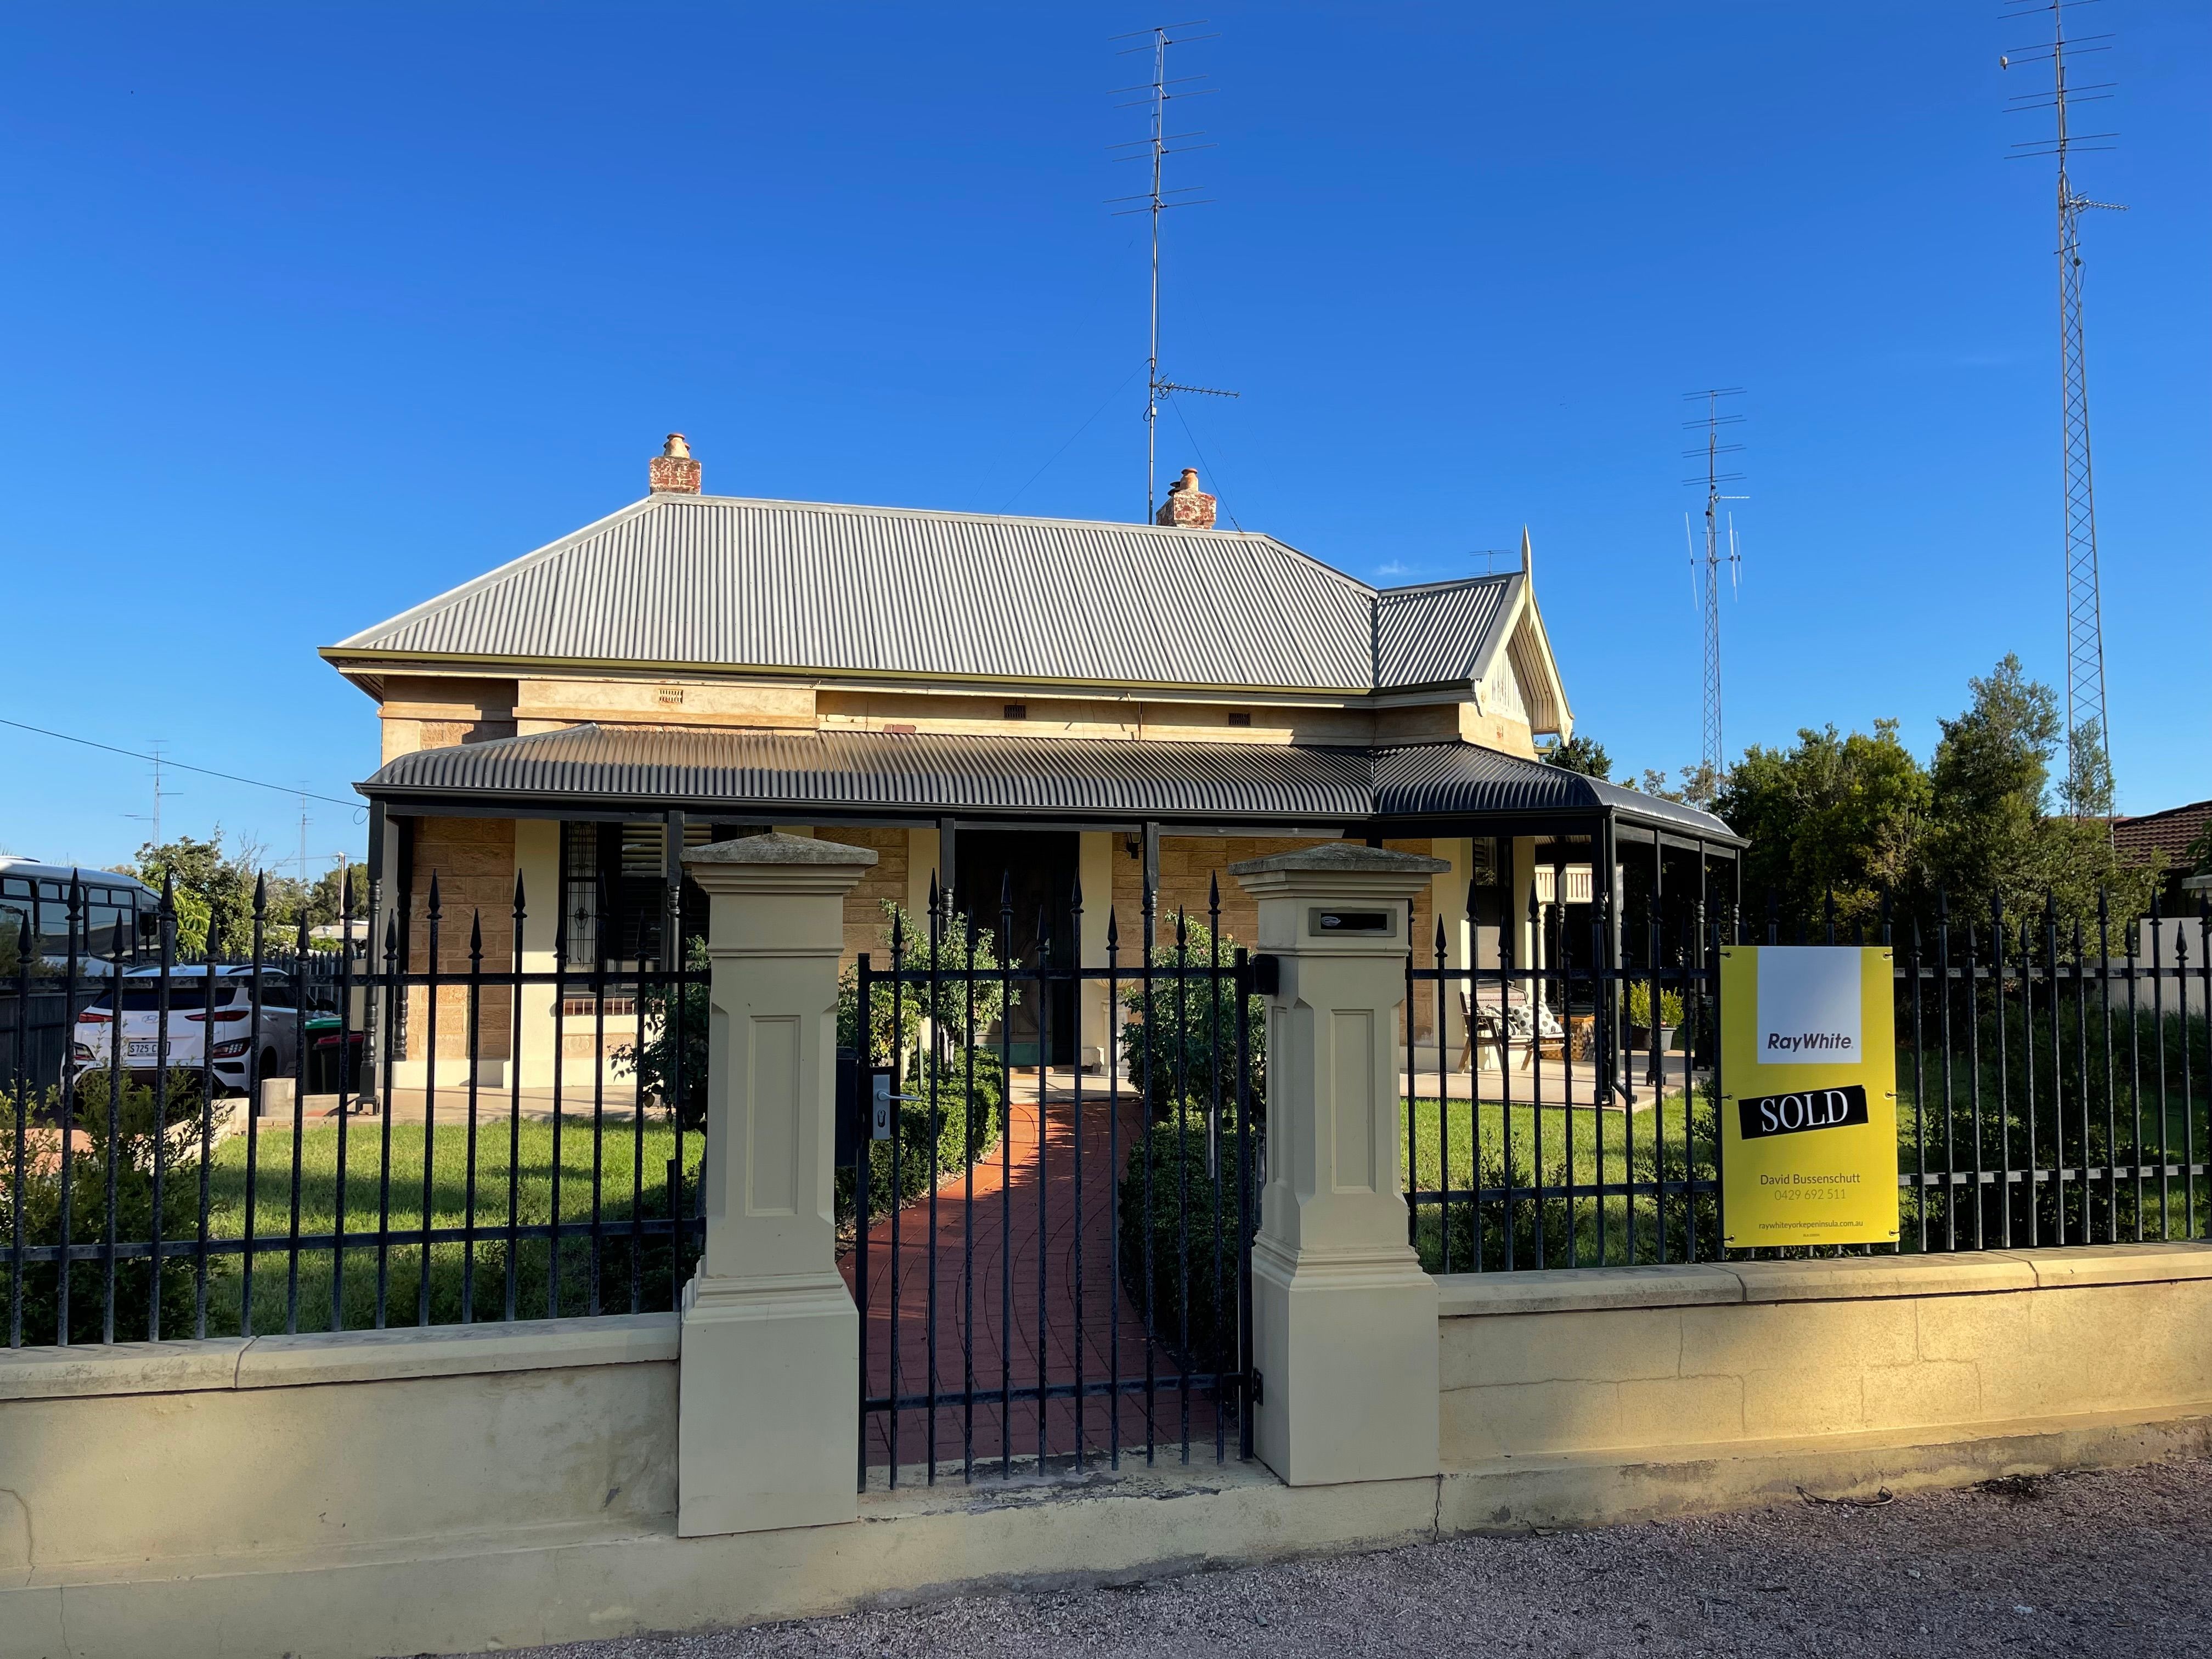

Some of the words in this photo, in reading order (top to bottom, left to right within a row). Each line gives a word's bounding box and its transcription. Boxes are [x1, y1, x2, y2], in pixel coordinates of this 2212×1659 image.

[1760, 1090, 1848, 1132] SOLD
[1760, 1173, 1790, 1185] David
[1793, 1172, 1861, 1184] Bussenschutt
[1774, 1189, 1801, 1201] 0429
[1804, 1189, 1824, 1200] 692
[1827, 1188, 1847, 1199] 511
[1759, 1220, 1864, 1231] raywhiteyorkepeninsula.com.au
